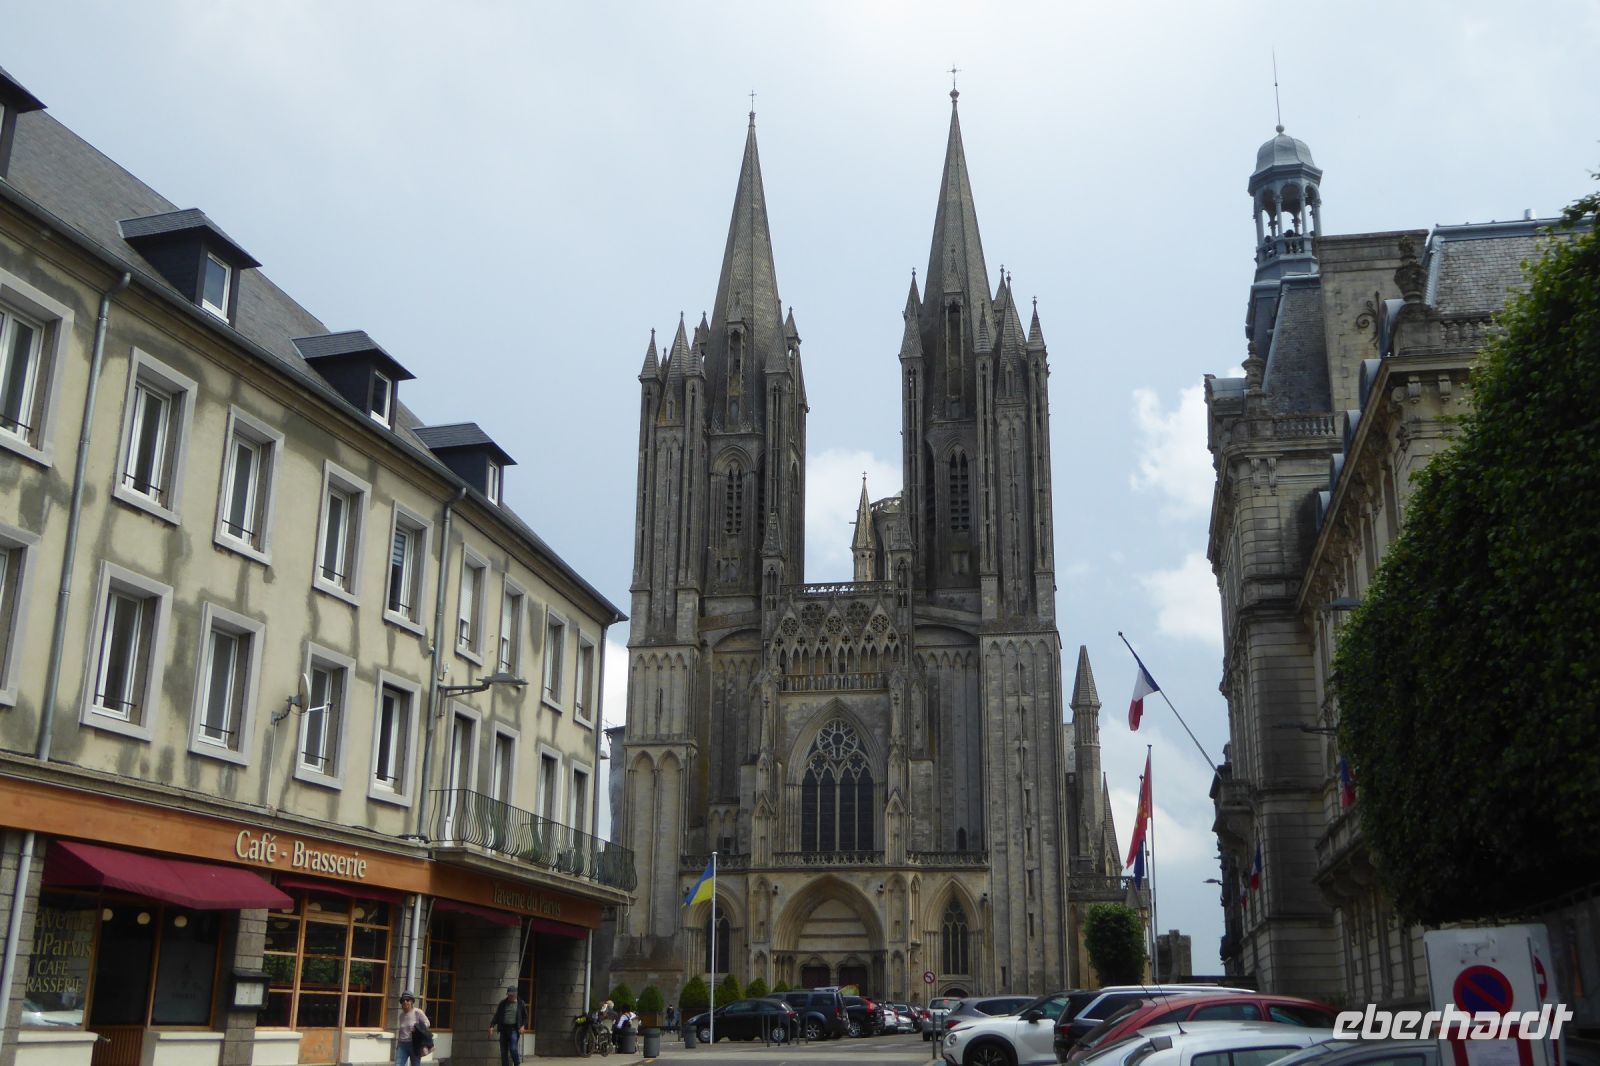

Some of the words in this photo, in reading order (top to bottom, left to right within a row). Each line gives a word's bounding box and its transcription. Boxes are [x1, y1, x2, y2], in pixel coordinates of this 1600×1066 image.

[235, 830, 277, 863] Café
[292, 840, 367, 878] Brasserie
[35, 909, 93, 930] averne
[26, 976, 82, 993] RASSERIE
